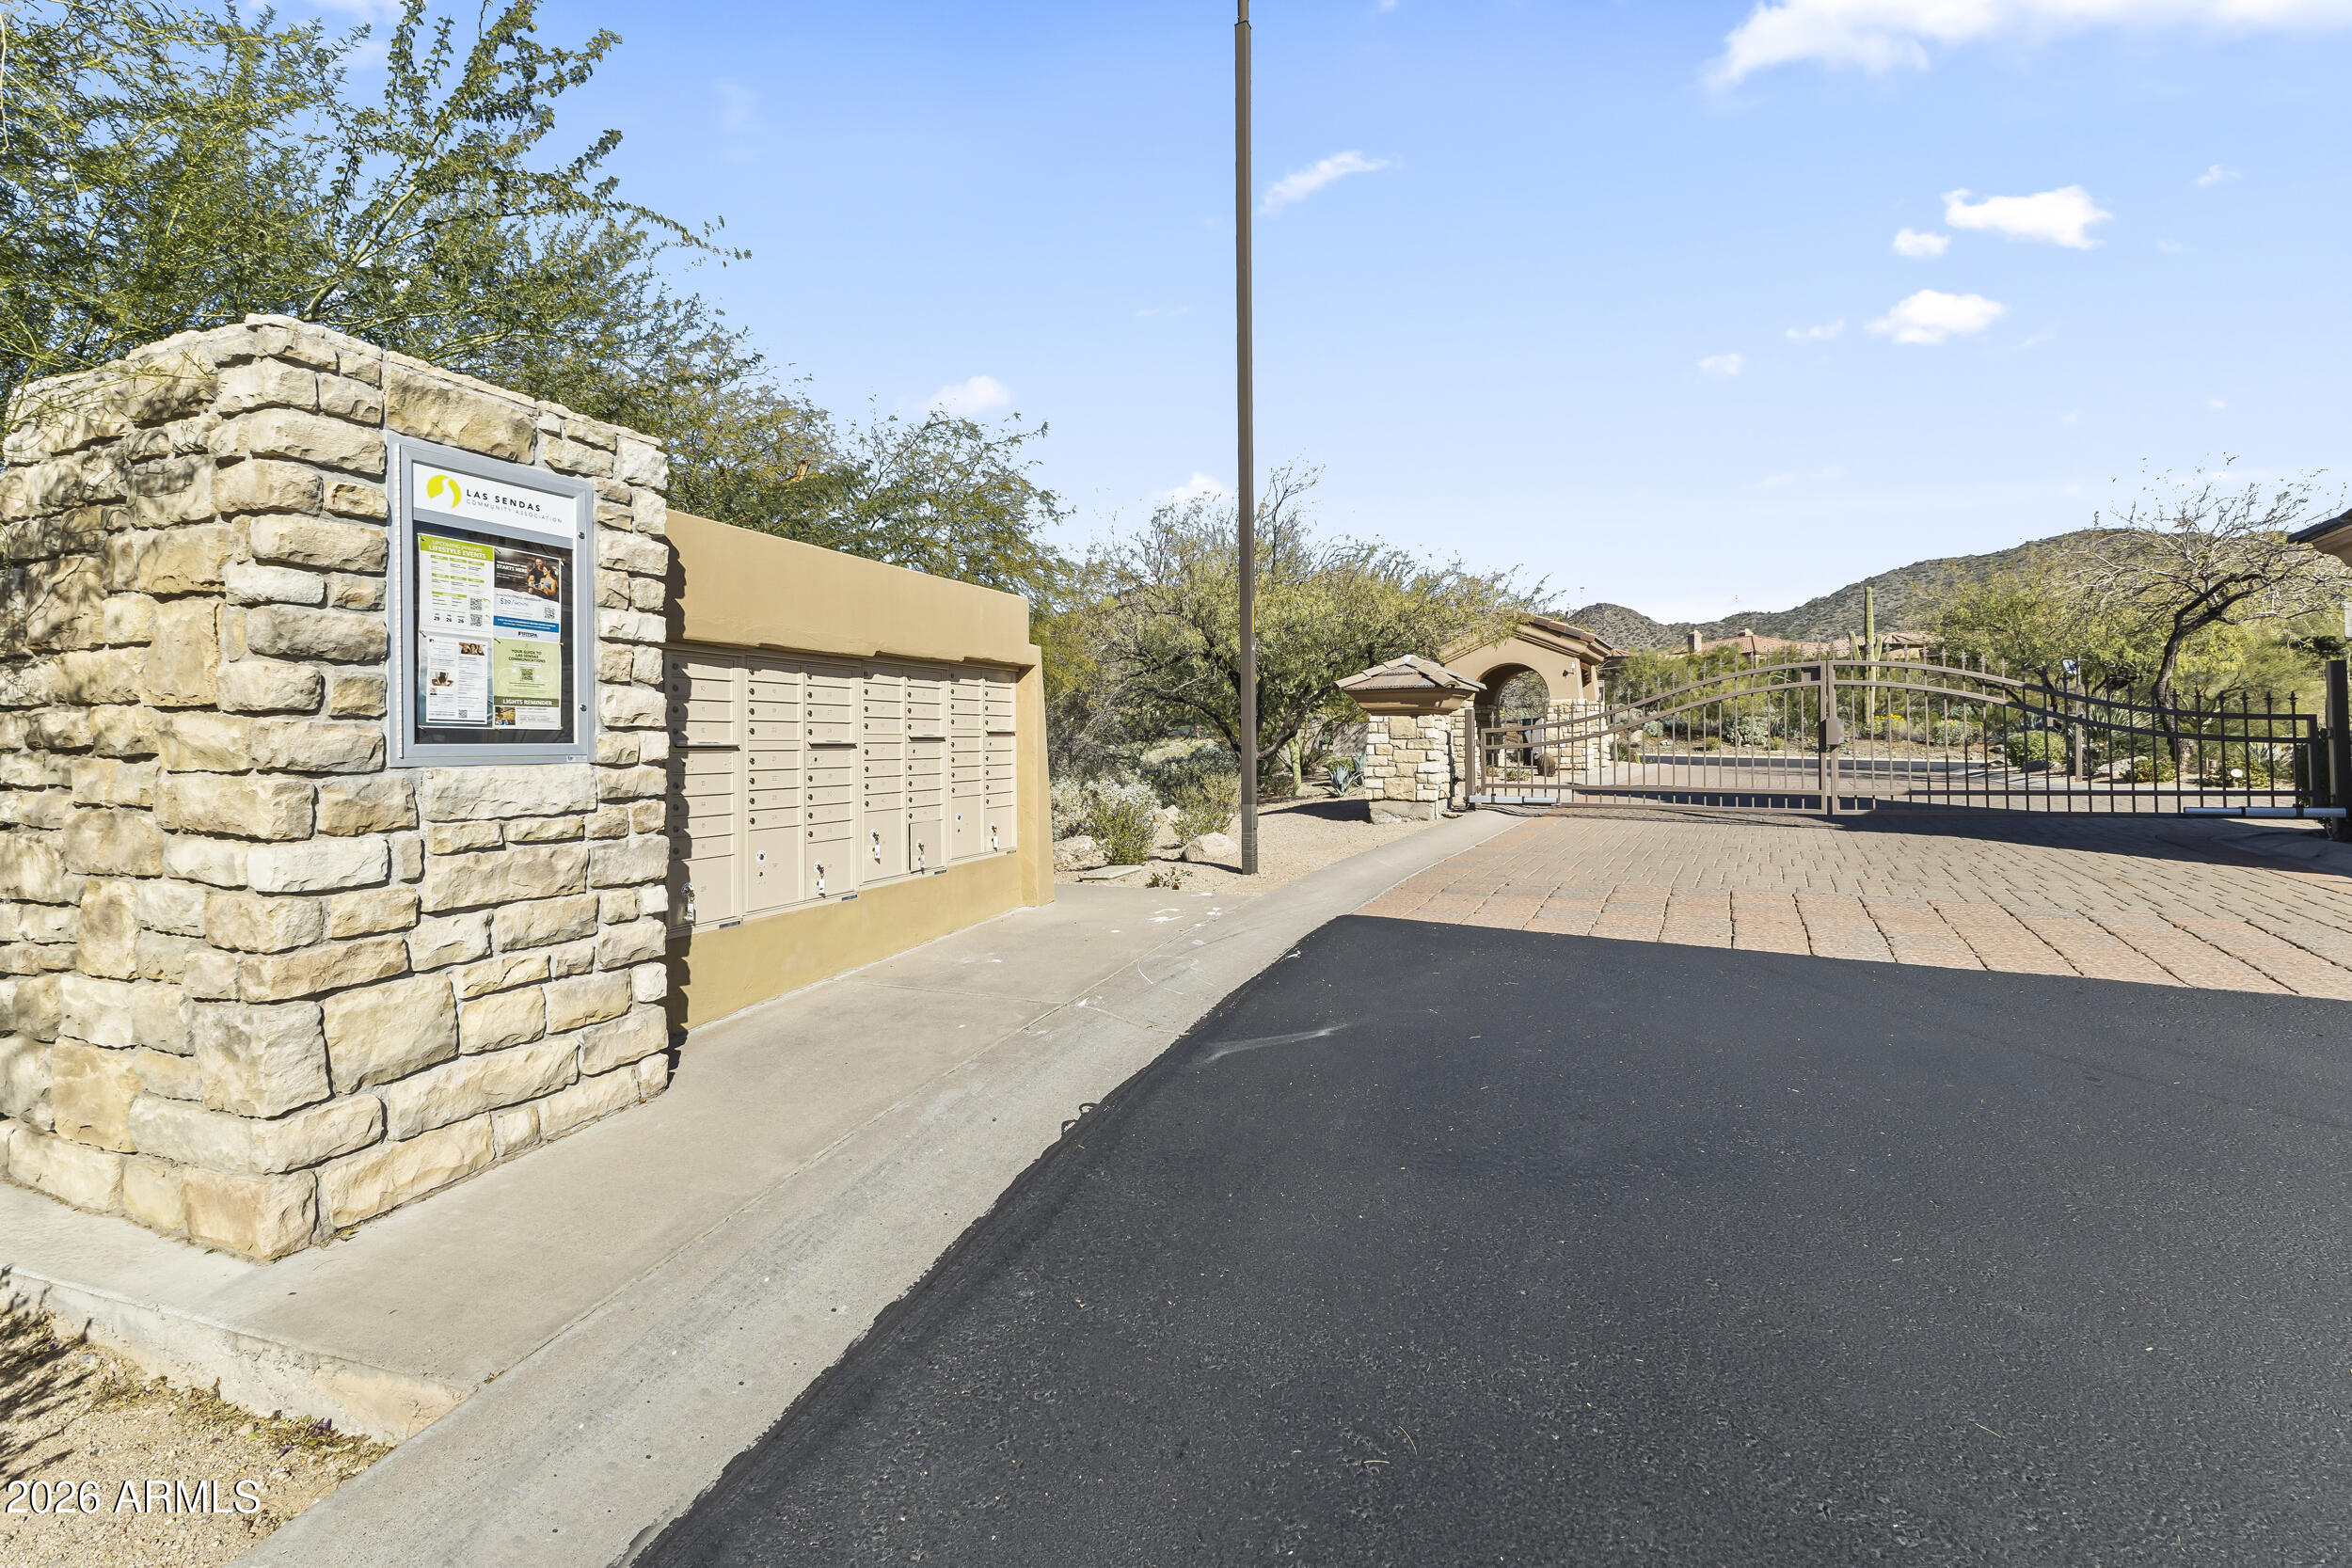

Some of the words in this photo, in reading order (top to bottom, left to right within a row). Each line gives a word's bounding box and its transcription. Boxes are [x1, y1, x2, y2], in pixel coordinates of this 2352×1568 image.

[466, 488, 488, 500] LAS
[495, 495, 541, 513] SENDAS
[466, 499, 512, 513] COMMUNITY
[516, 510, 563, 524] ASSOCIATION
[428, 545, 461, 555] LIFESTYLE
[463, 549, 486, 560] EVENTS
